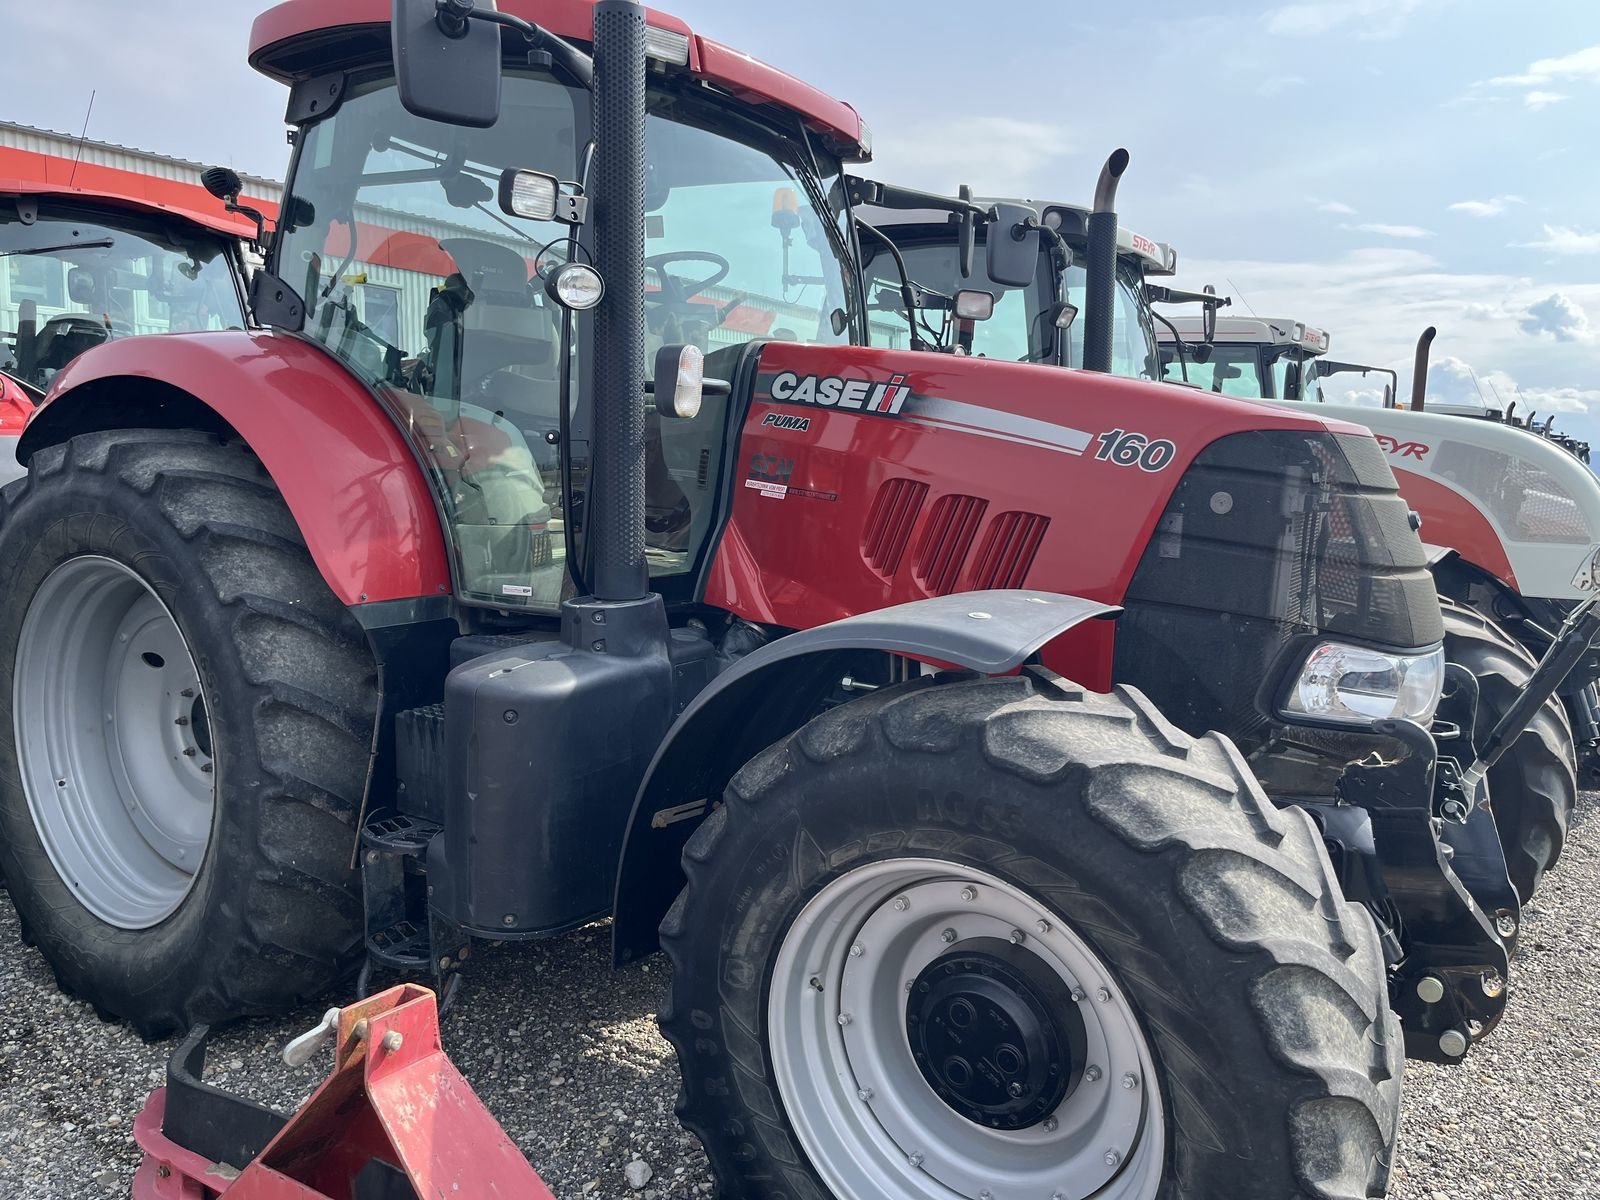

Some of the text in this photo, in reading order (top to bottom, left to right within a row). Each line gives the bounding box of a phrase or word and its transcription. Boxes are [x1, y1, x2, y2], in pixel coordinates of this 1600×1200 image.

[1132, 234, 1156, 255] STEYR
[771, 372, 870, 409] CASE
[762, 412, 811, 432] PUMA
[1094, 428, 1177, 473] 160
[1373, 433, 1430, 461] EYR
